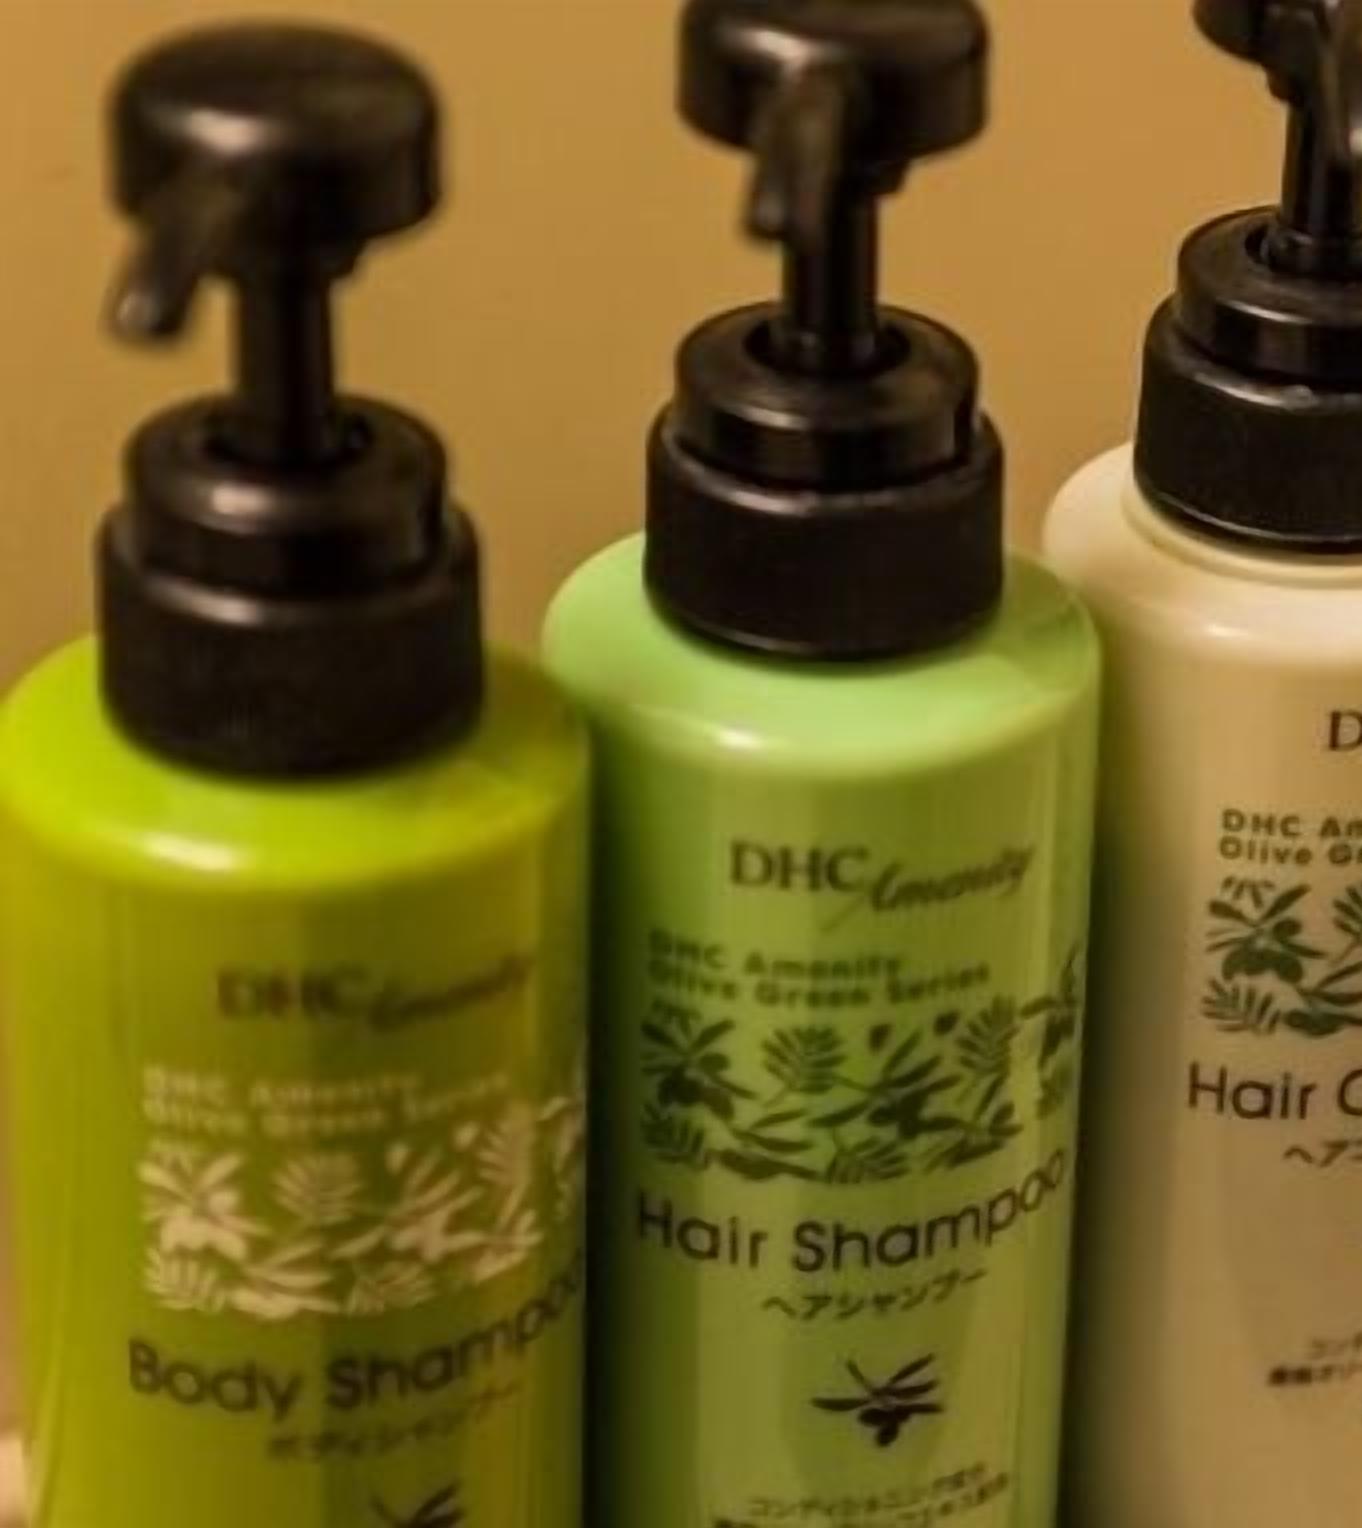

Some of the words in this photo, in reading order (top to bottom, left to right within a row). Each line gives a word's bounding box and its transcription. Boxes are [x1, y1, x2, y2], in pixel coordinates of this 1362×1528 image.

[1218, 835, 1314, 866] Olive
[1221, 807, 1302, 838] DHC
[729, 837, 872, 894] DHC
[821, 843, 1036, 932] Amenity
[647, 928, 728, 970] DHC
[744, 947, 904, 980] Amenity
[647, 958, 738, 1001] Olive
[755, 978, 871, 1008] Green
[887, 959, 991, 1005] Series
[1187, 1061, 1318, 1121] Hair
[637, 1187, 769, 1269] Hair
[790, 1148, 1066, 1273] Shampoo
[127, 1335, 303, 1422] Body
